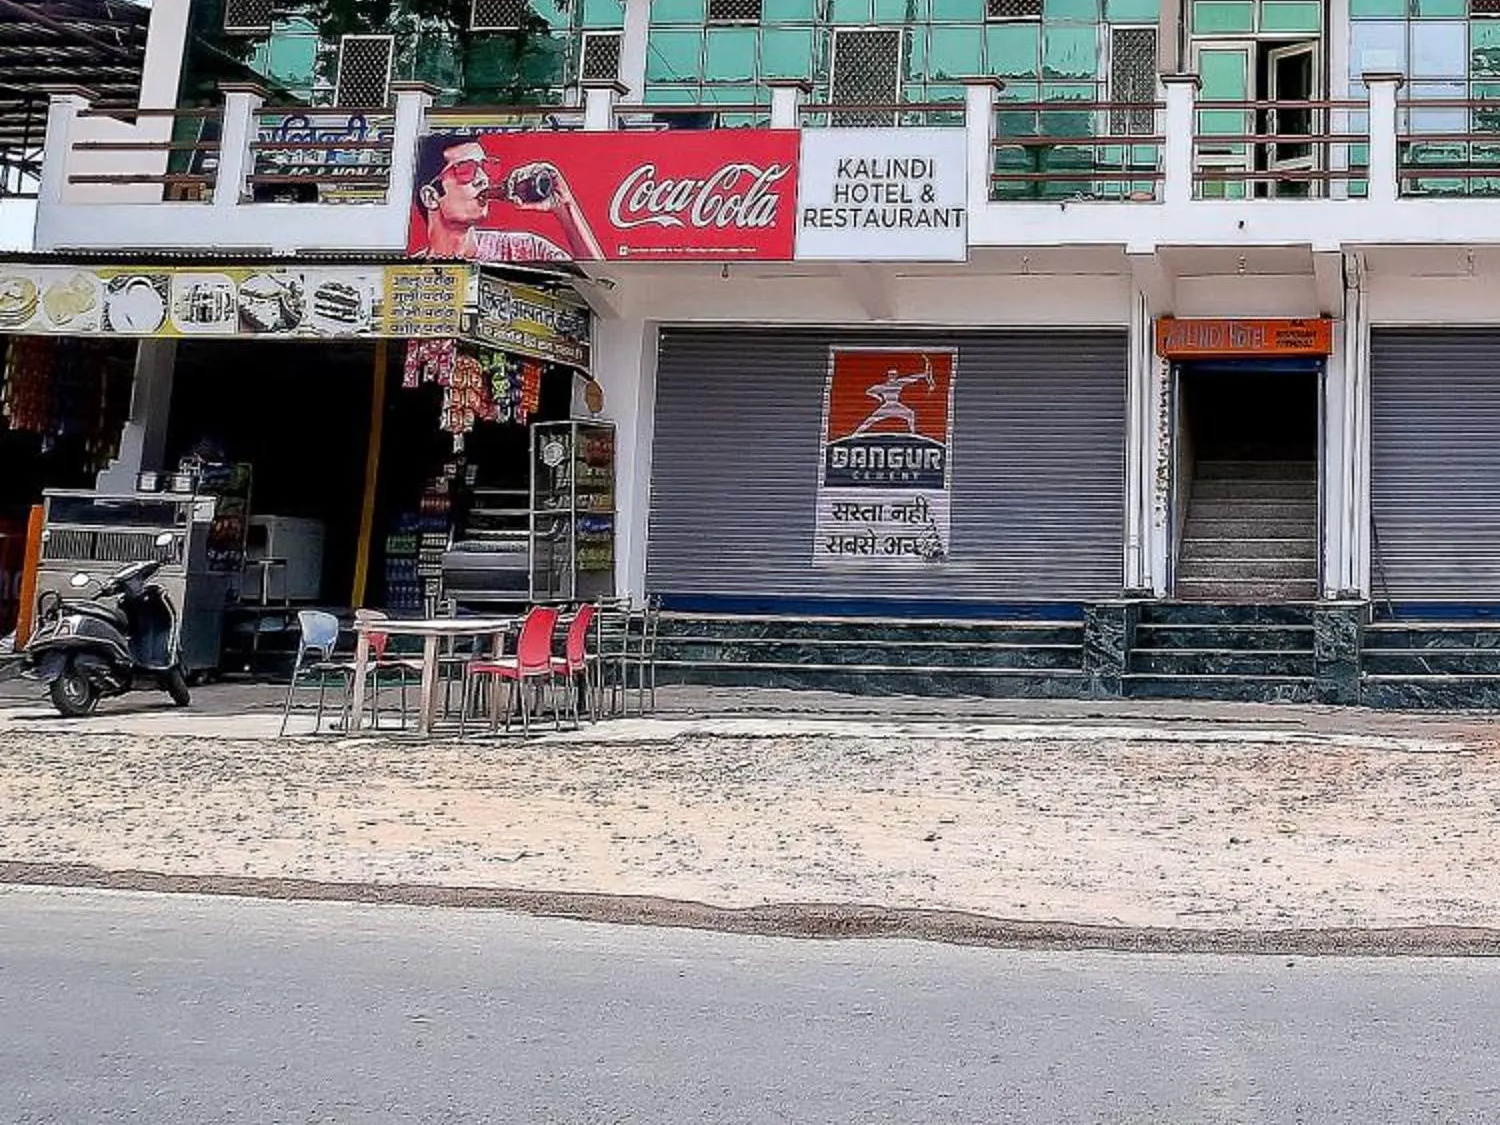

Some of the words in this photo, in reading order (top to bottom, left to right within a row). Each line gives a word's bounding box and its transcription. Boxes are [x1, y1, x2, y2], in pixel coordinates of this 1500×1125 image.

[837, 158, 934, 179] KALINDI
[608, 162, 792, 229] Coca-Cola
[835, 183, 912, 204] HOTEL
[921, 184, 935, 203] &
[804, 208, 965, 228] RESTAURANT
[832, 446, 943, 470] BANGUR
[832, 502, 883, 523] सस्ता
[826, 529, 879, 555] सबसे
